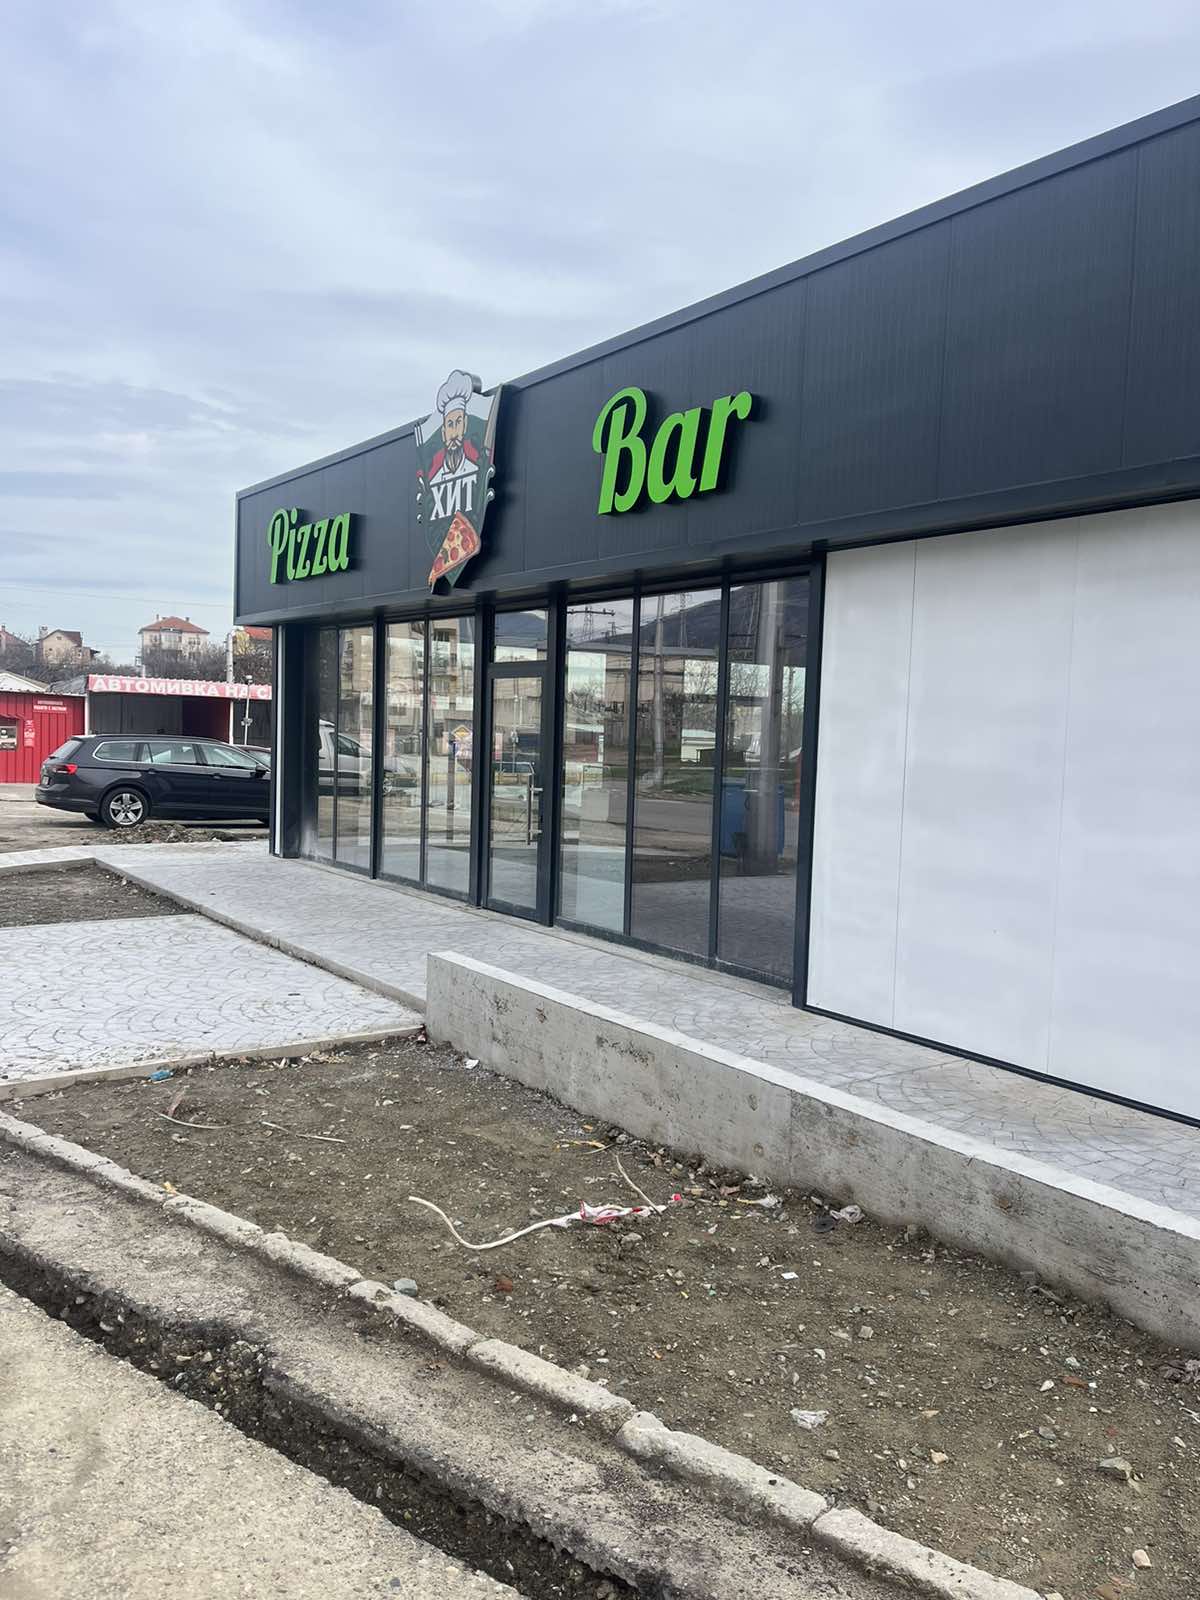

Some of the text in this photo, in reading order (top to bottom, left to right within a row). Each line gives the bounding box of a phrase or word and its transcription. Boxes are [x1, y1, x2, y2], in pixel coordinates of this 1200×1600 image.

[592, 386, 753, 515] Bar
[430, 474, 477, 520] ХИТ
[267, 507, 351, 584] Pizza
[93, 678, 219, 696] АВТОМИВКА
